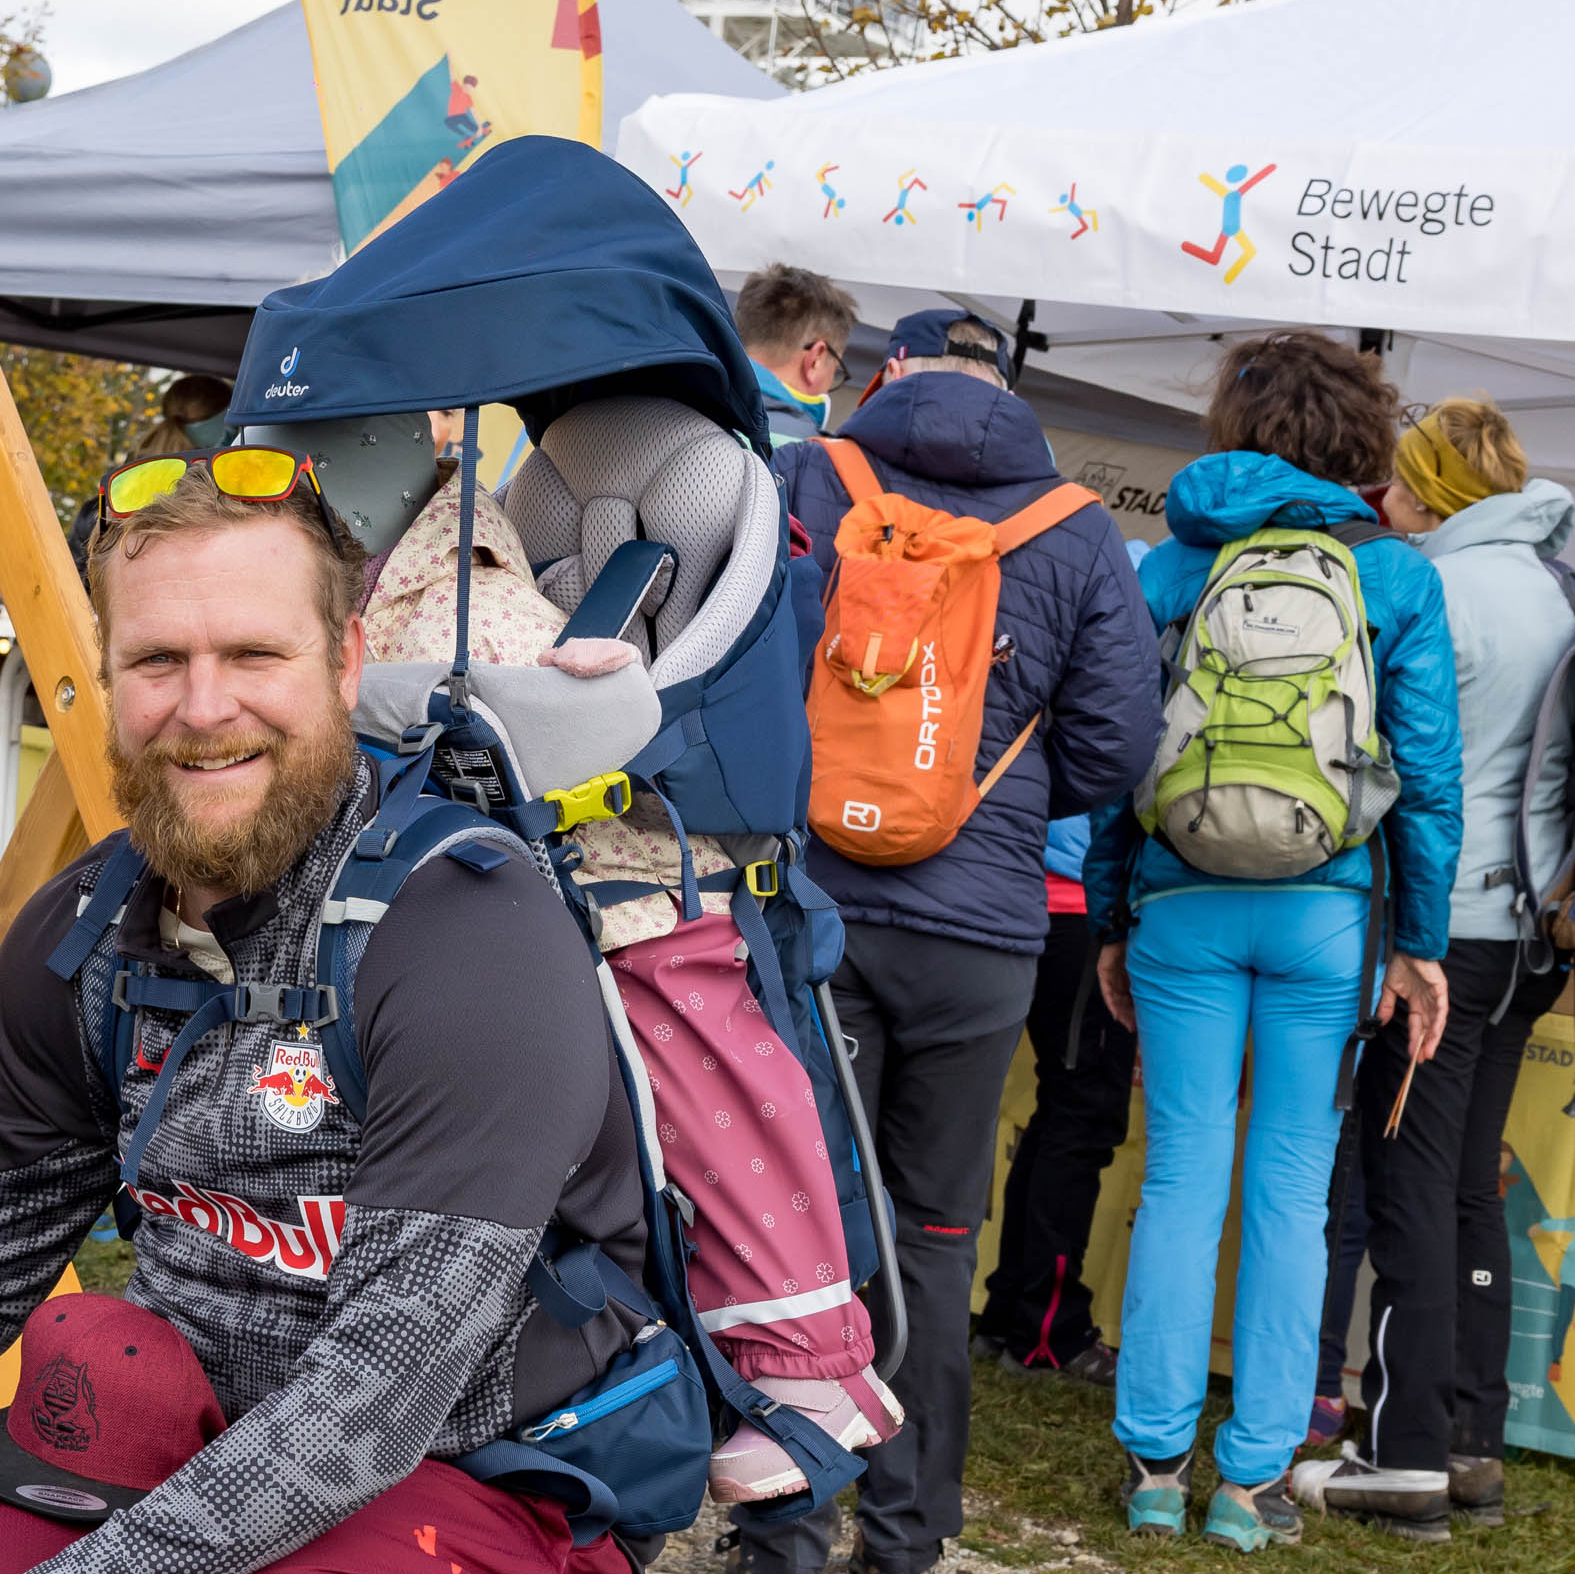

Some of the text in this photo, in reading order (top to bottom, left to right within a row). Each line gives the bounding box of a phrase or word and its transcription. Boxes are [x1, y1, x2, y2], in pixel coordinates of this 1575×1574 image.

[1296, 178, 1495, 236] Bewegte
[1287, 231, 1412, 284] Stadt
[265, 380, 310, 399] deuter
[1109, 486, 1167, 516] STAD
